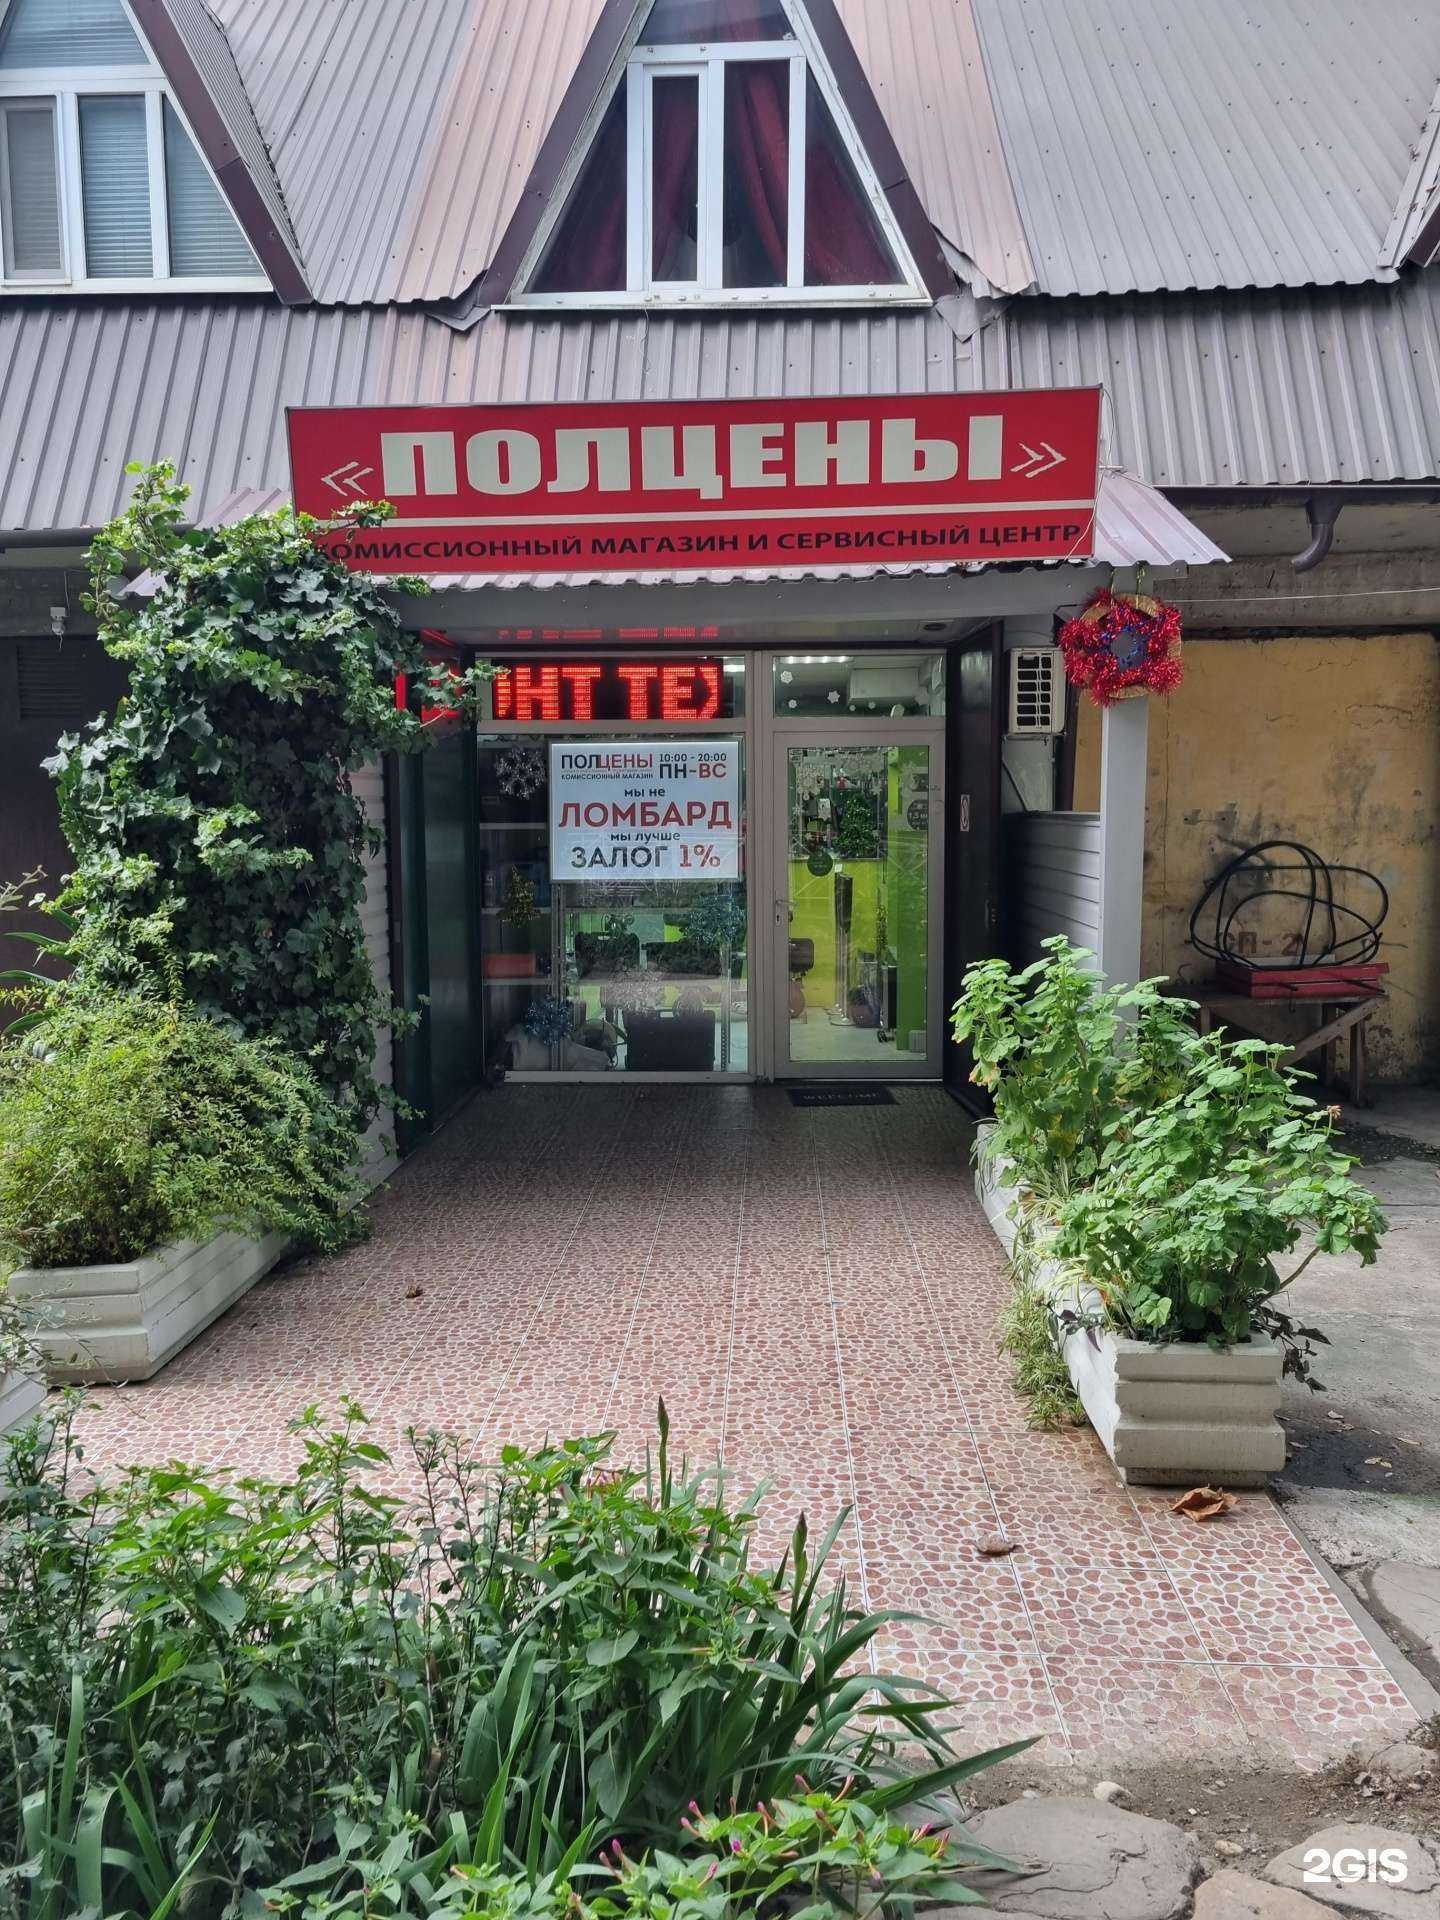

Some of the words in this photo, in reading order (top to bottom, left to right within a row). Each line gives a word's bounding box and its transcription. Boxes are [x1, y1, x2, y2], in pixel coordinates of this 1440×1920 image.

[381, 414, 1003, 500] ПОЛЦЕНЫ
[592, 534, 739, 555] МАГАЗИН
[747, 533, 768, 551] И
[776, 524, 971, 550] СЕРВИСНЫЙ
[979, 524, 1081, 547] ЦЕНТР
[561, 753, 653, 772] ПОЛЦЕНЫ
[659, 753, 688, 762] 10:00
[698, 752, 727, 762] 20:00
[561, 772, 620, 780] КОМИССИОННЫЙ
[622, 772, 654, 780] МАГАЗИН
[659, 763, 727, 779] ПН-ВС
[624, 788, 645, 797] мы
[649, 787, 666, 797] не
[559, 801, 732, 829] ЛОМБАРД
[610, 832, 631, 841] мы
[635, 831, 681, 844] лучше
[571, 845, 668, 868] ЗАЛОГ
[679, 844, 721, 868] 1%
